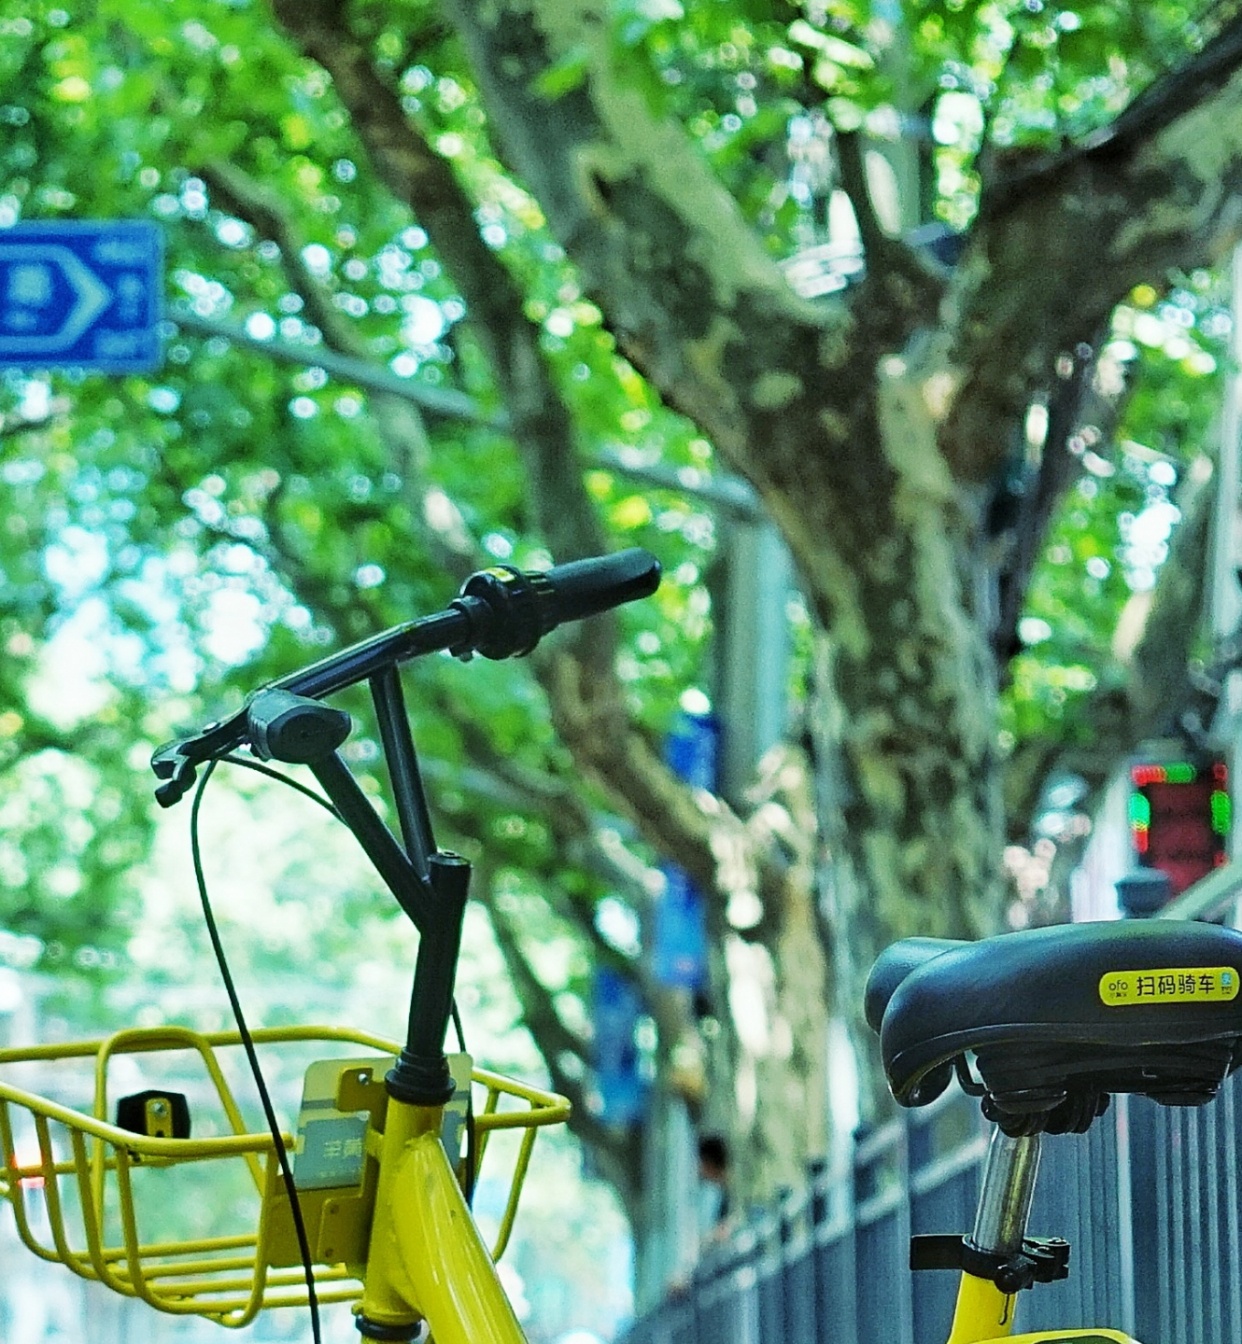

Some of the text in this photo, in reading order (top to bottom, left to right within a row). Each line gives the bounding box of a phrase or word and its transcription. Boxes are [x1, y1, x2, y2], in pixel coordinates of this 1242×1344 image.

[1109, 979, 1128, 991] ofo
[1136, 973, 1215, 996] 扫码骑车
